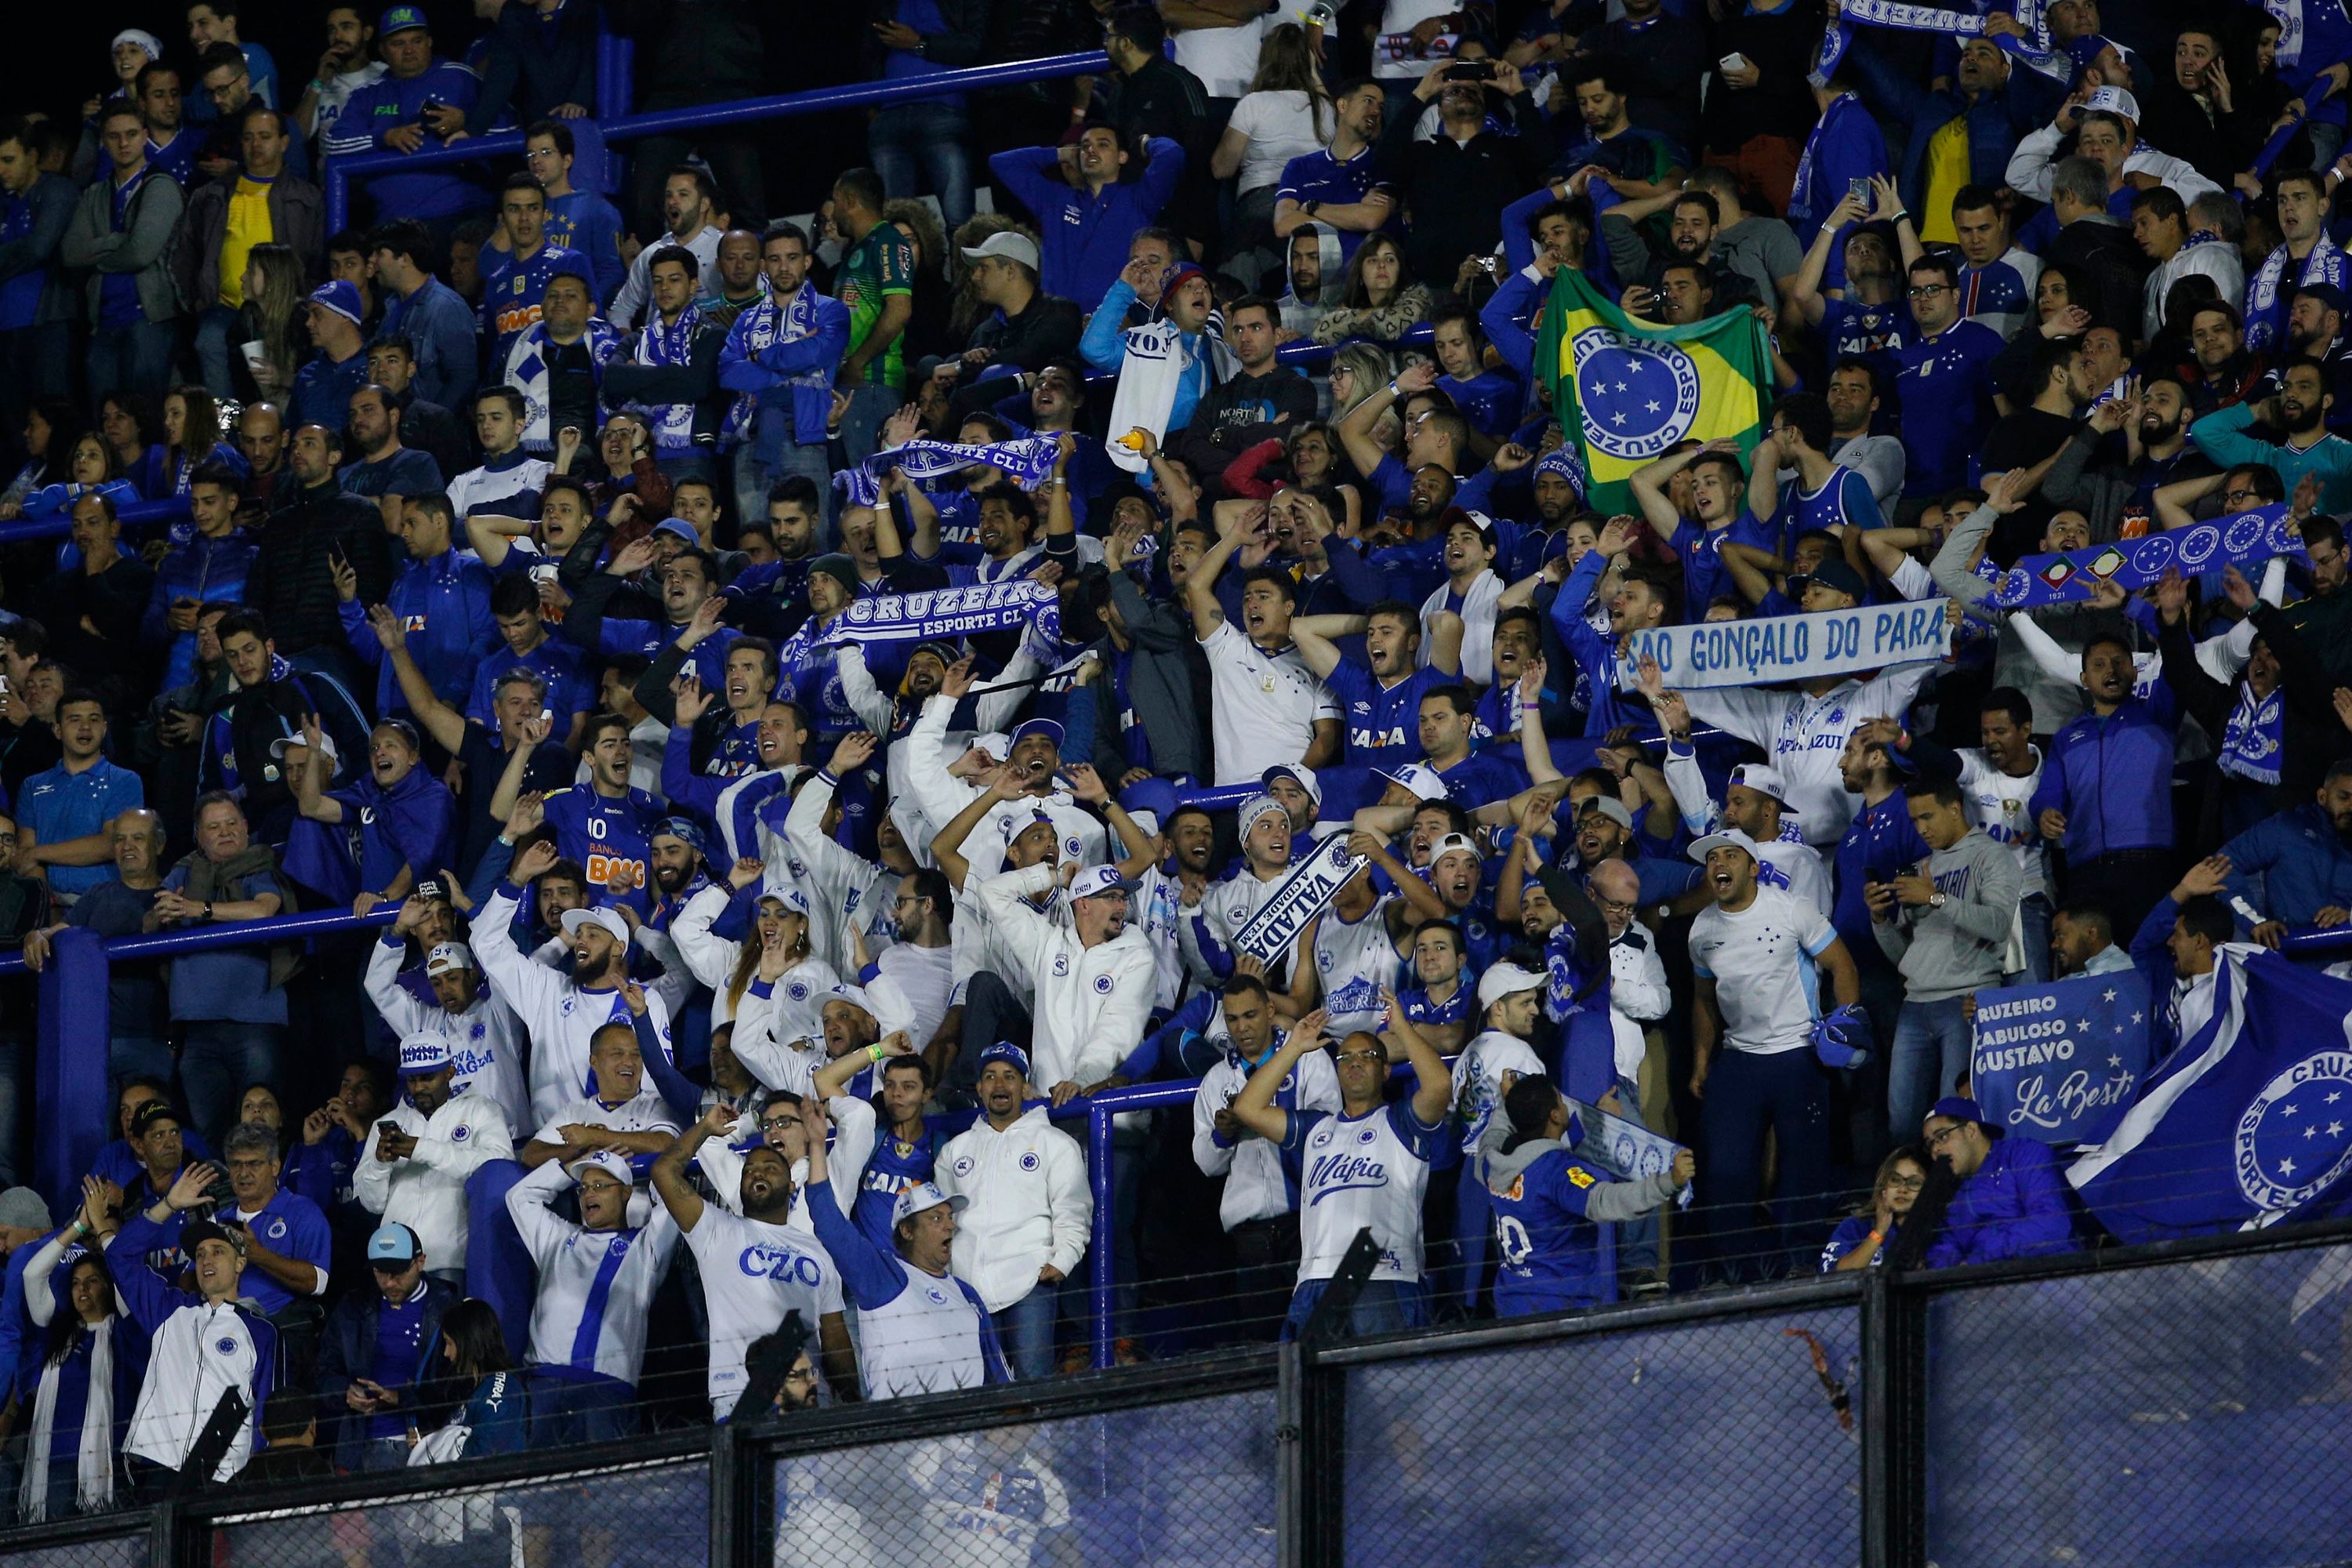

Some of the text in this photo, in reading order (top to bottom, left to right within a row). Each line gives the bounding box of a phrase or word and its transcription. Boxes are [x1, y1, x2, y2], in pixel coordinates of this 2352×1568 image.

[1838, 332, 1902, 354] CAIXA
[1219, 407, 1256, 419] NORTH
[1579, 414, 1679, 456] CRUZEI
[907, 438, 986, 459] ESPORTE
[992, 452, 1029, 471] CLU
[941, 526, 982, 544] CAIX
[847, 579, 1058, 623] CRUZEIRO
[2049, 592, 2066, 601] 1921
[923, 612, 996, 637] ESPORTE
[1691, 622, 1809, 676] GONÇALO
[1825, 616, 1859, 660] DO
[706, 758, 758, 776] AIXA
[587, 818, 607, 840] 10
[586, 855, 645, 889] BMG
[1241, 872, 1309, 946] A CIDADE TEM
[1977, 996, 2056, 1023] RUZEIRO
[1976, 1039, 2074, 1075] GUSTAVO
[2292, 1057, 2352, 1083] CRUZ
[2009, 1075, 2062, 1128] La
[2239, 1098, 2286, 1206] ESPORTE
[863, 1170, 922, 1196] CAIX
[1305, 1153, 1387, 1196] Máfia
[739, 1246, 822, 1287] CZO
